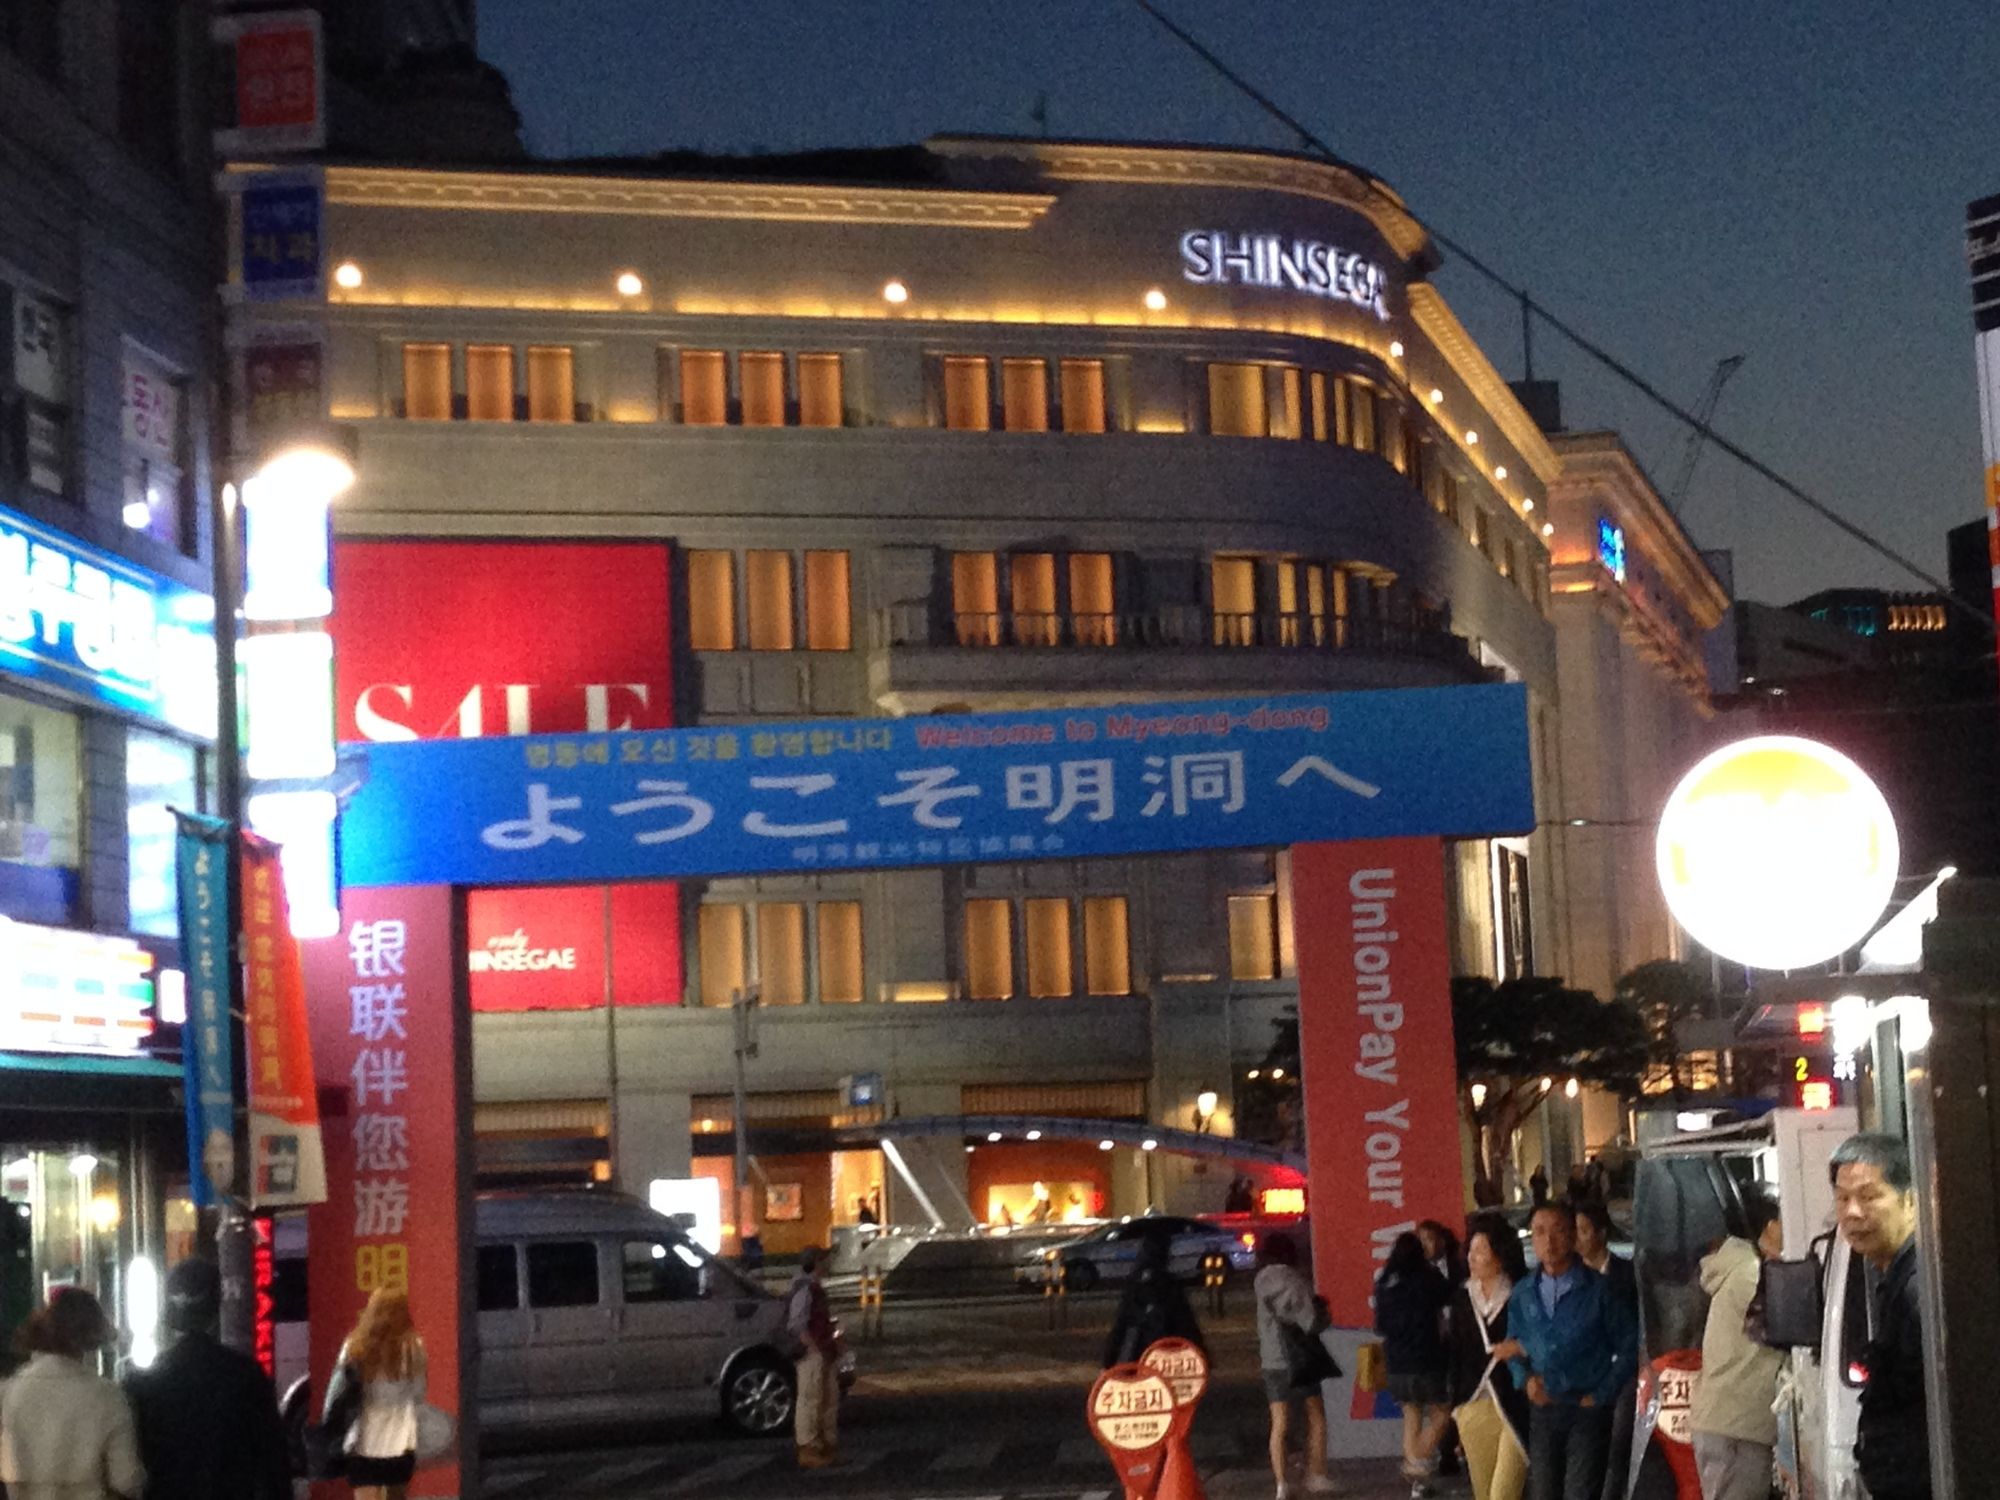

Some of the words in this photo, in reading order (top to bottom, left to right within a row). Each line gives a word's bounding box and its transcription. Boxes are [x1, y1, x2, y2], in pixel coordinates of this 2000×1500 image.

[620, 738, 675, 765] 오신
[752, 727, 892, 758] 환영합니다
[915, 722, 1055, 748] Welcome
[1065, 718, 1096, 741] to
[1106, 706, 1329, 742] Myeong-dong
[481, 752, 1382, 849] ようこそ明洞へ
[1349, 868, 1404, 1086] UnionPay
[1363, 1098, 1410, 1209] Your
[1101, 1386, 1164, 1413] 주차금지
